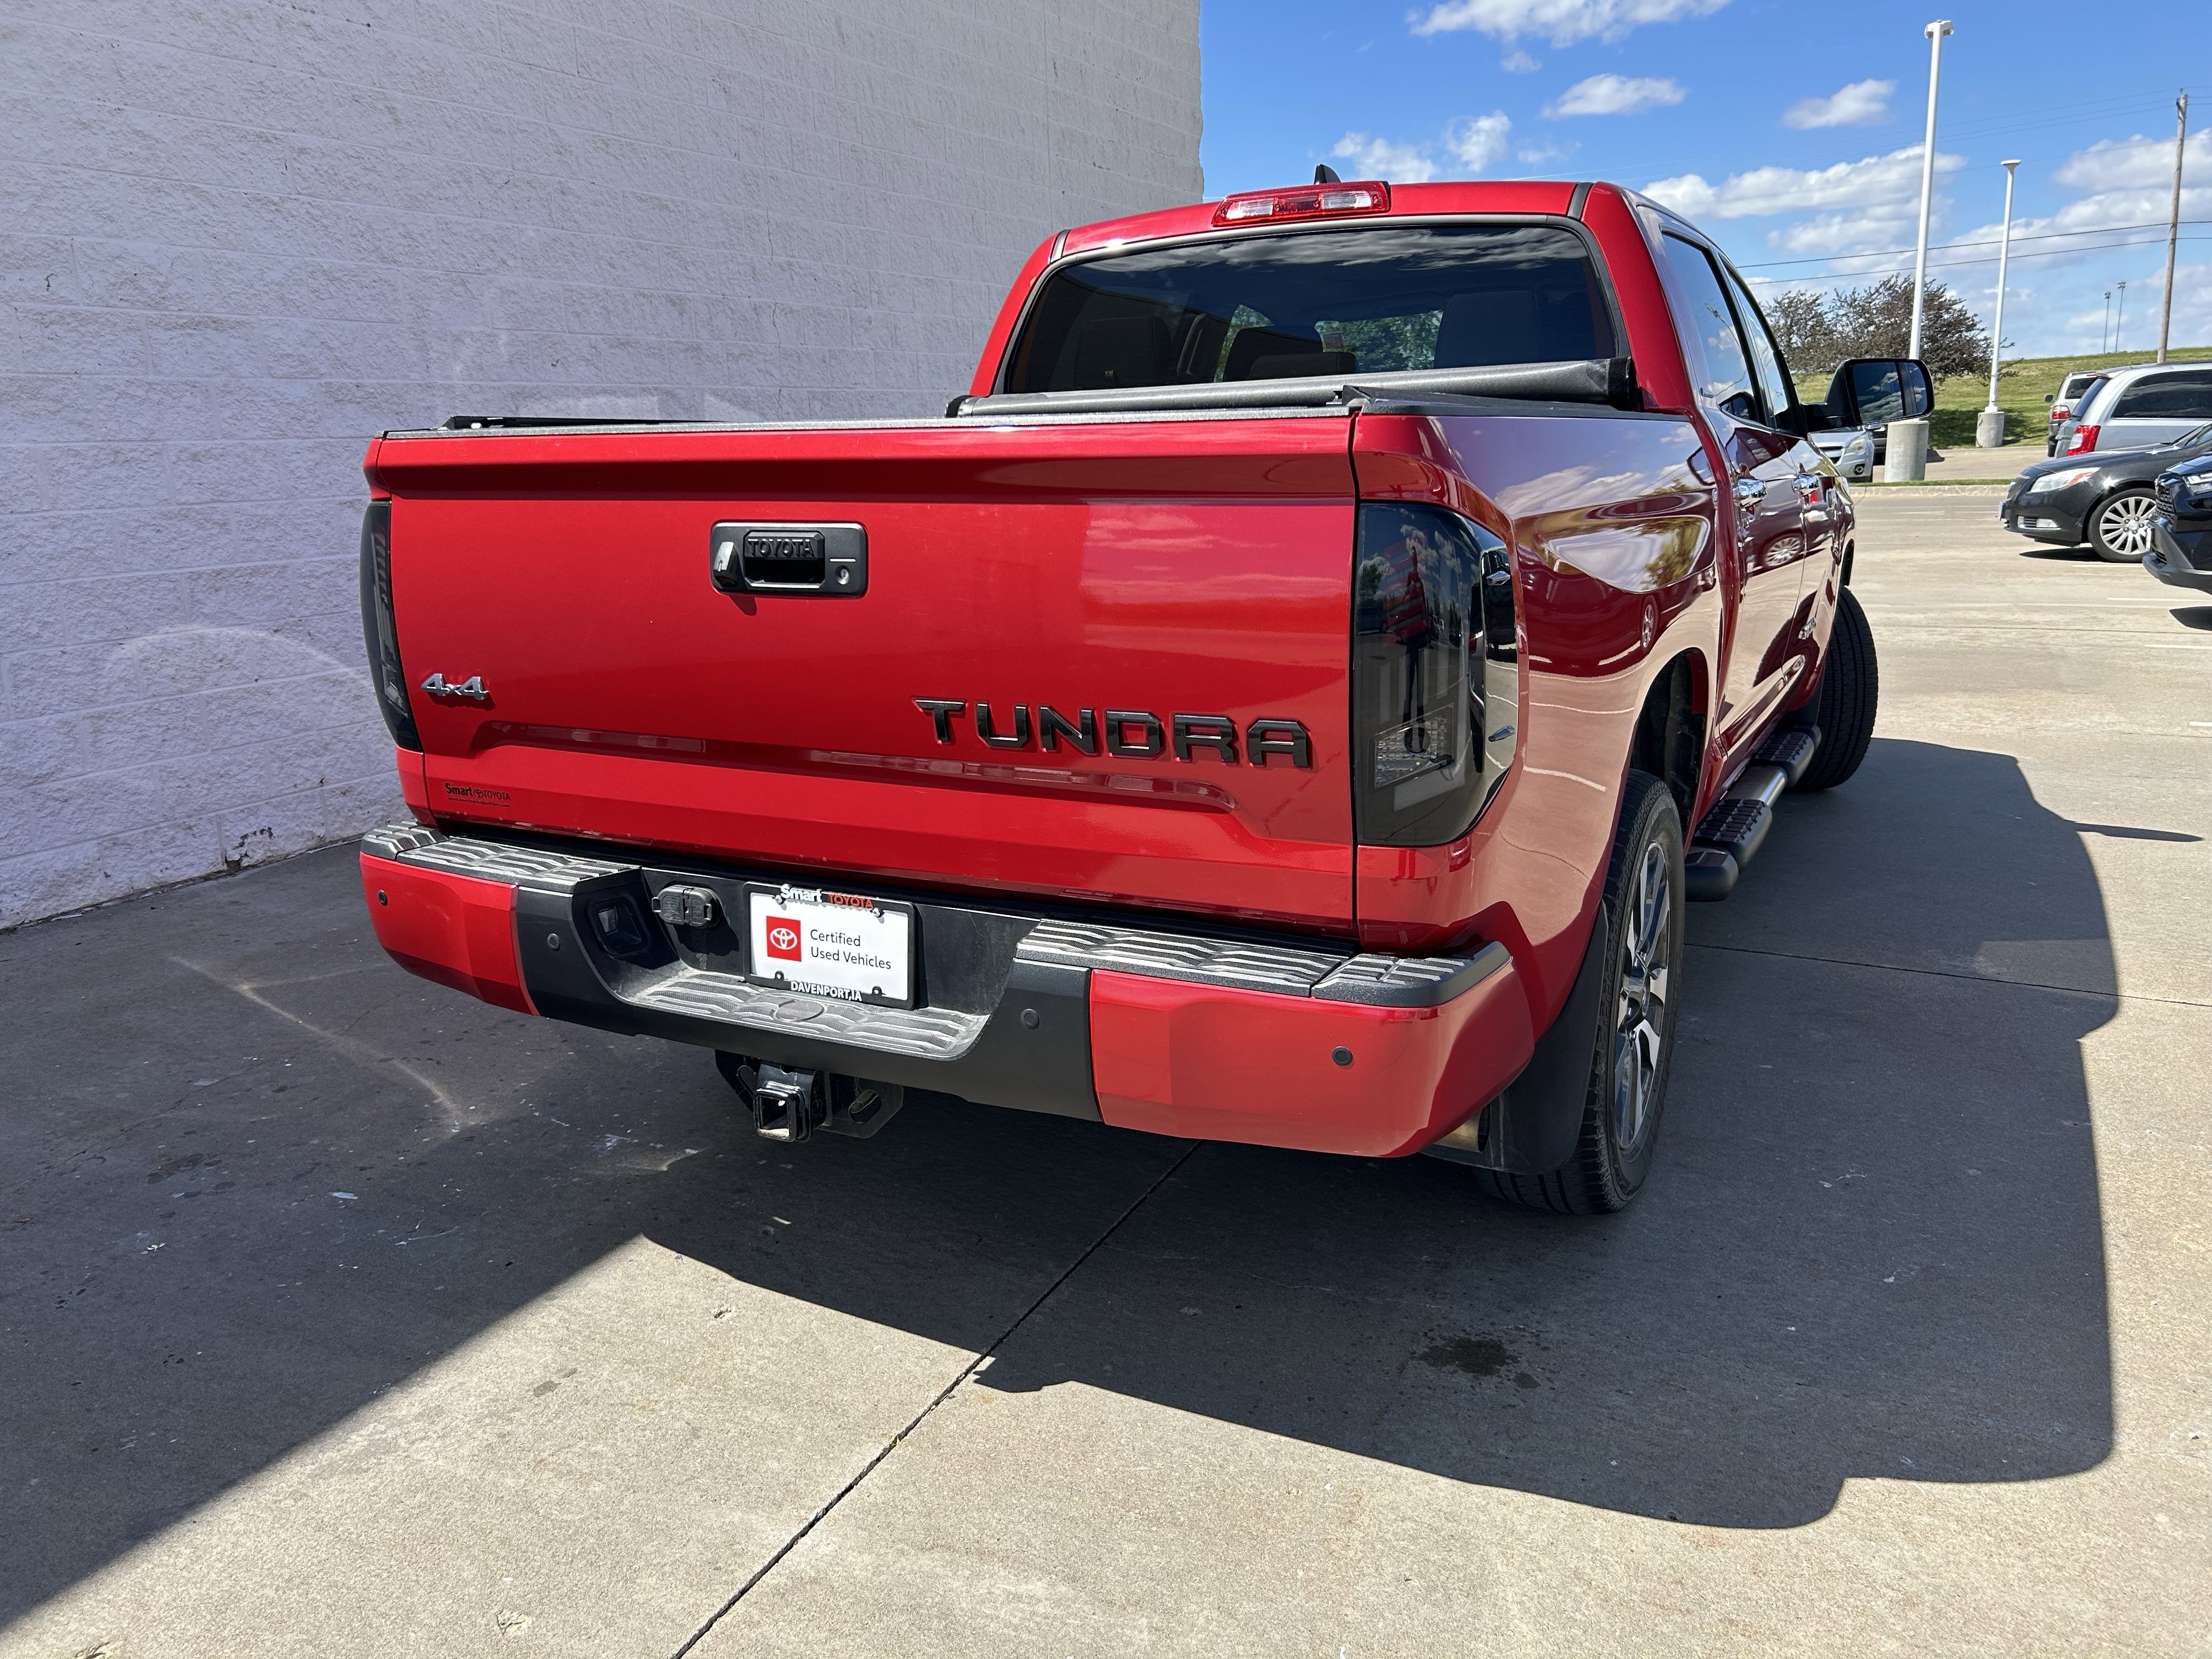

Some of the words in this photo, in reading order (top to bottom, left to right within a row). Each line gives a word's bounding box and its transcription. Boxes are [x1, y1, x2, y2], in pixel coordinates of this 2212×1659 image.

[747, 539, 816, 557] TOYOTA
[421, 673, 489, 700] 4x4
[911, 697, 1312, 769] TUNDRA
[445, 783, 473, 797] Smart
[483, 790, 510, 800] TOYOTA
[780, 884, 822, 903] Smart
[828, 894, 874, 909] TOYOTA
[810, 929, 861, 947] Certified
[811, 946, 840, 962] Used
[843, 951, 891, 969] Vehicles
